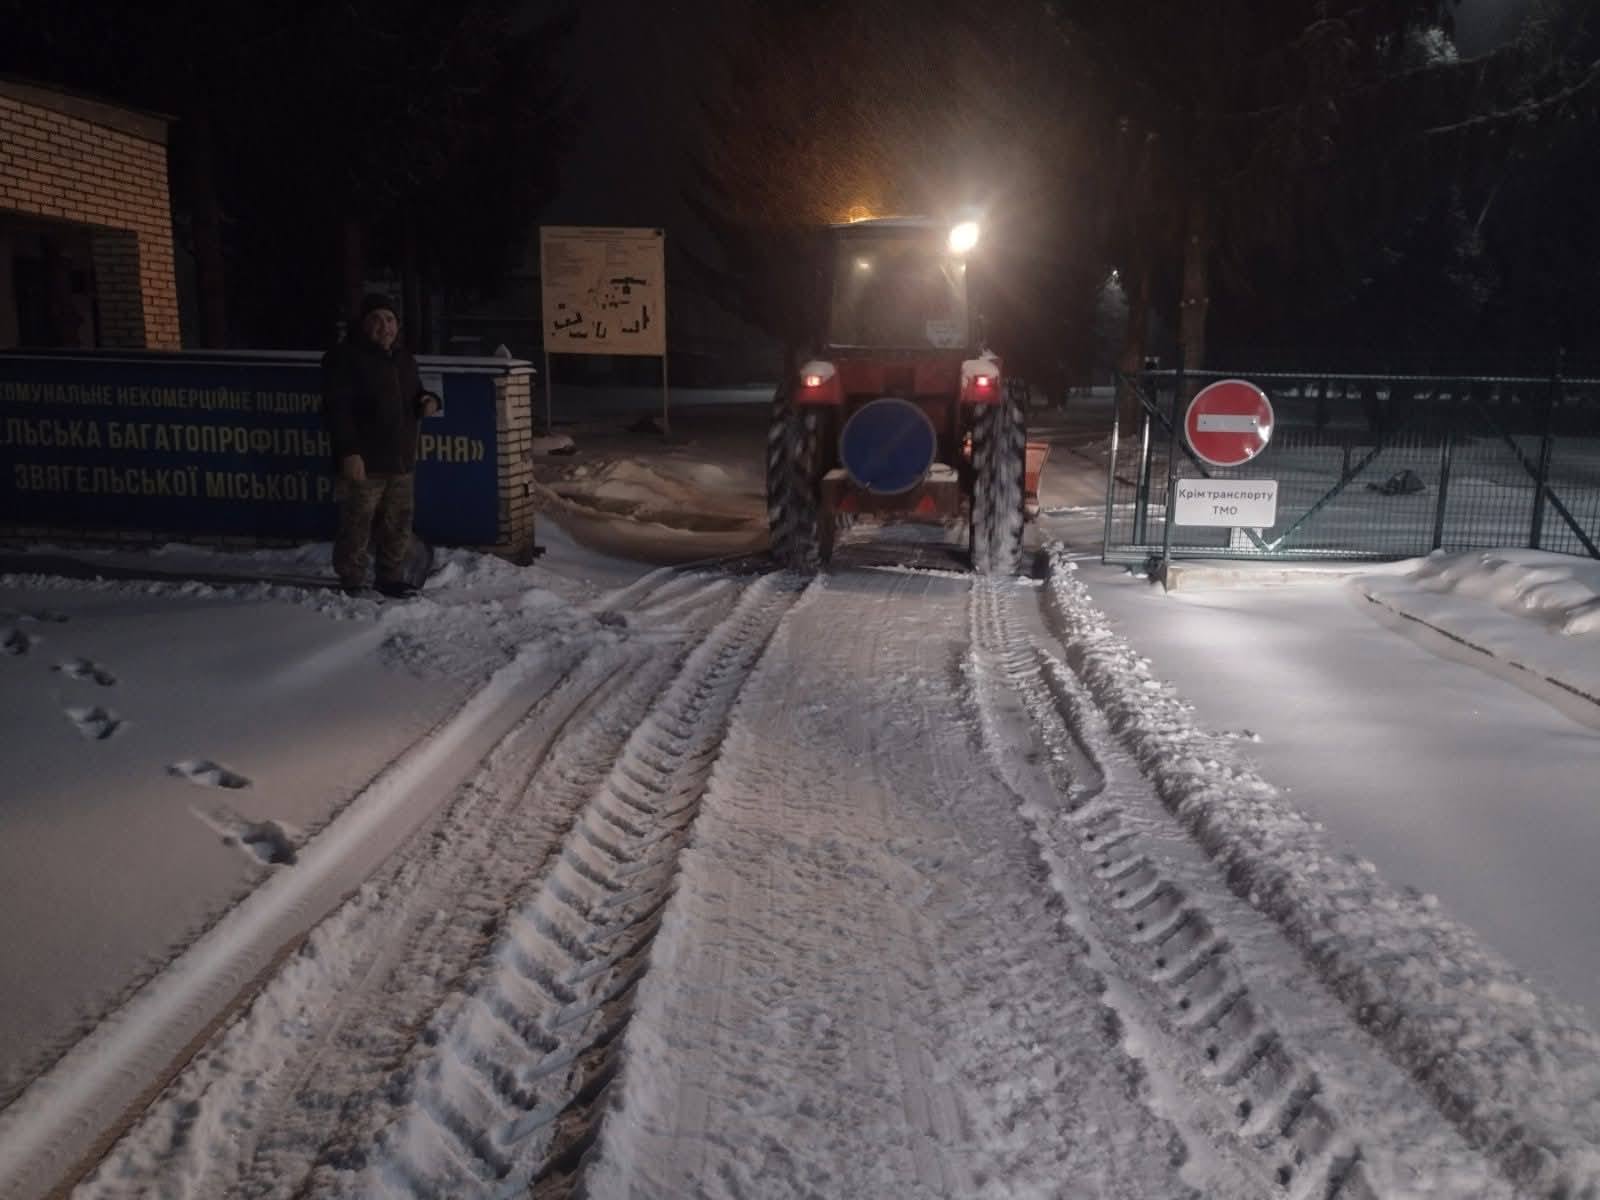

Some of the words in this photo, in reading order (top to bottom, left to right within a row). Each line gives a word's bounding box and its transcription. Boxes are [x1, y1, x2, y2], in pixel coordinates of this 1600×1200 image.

[117, 385, 253, 411] НЕКОМЕРЦІЙНЕ
[0, 417, 102, 448] ЛЬСЬКА
[15, 464, 199, 497] ЗВЯГЕЛЬСЬКОЇ
[205, 470, 308, 502] МІСЬКОЇ
[317, 475, 337, 503] Р
[1179, 489, 1205, 500] Крім
[1207, 490, 1273, 503] транспорту
[1213, 505, 1238, 516] ТМО
